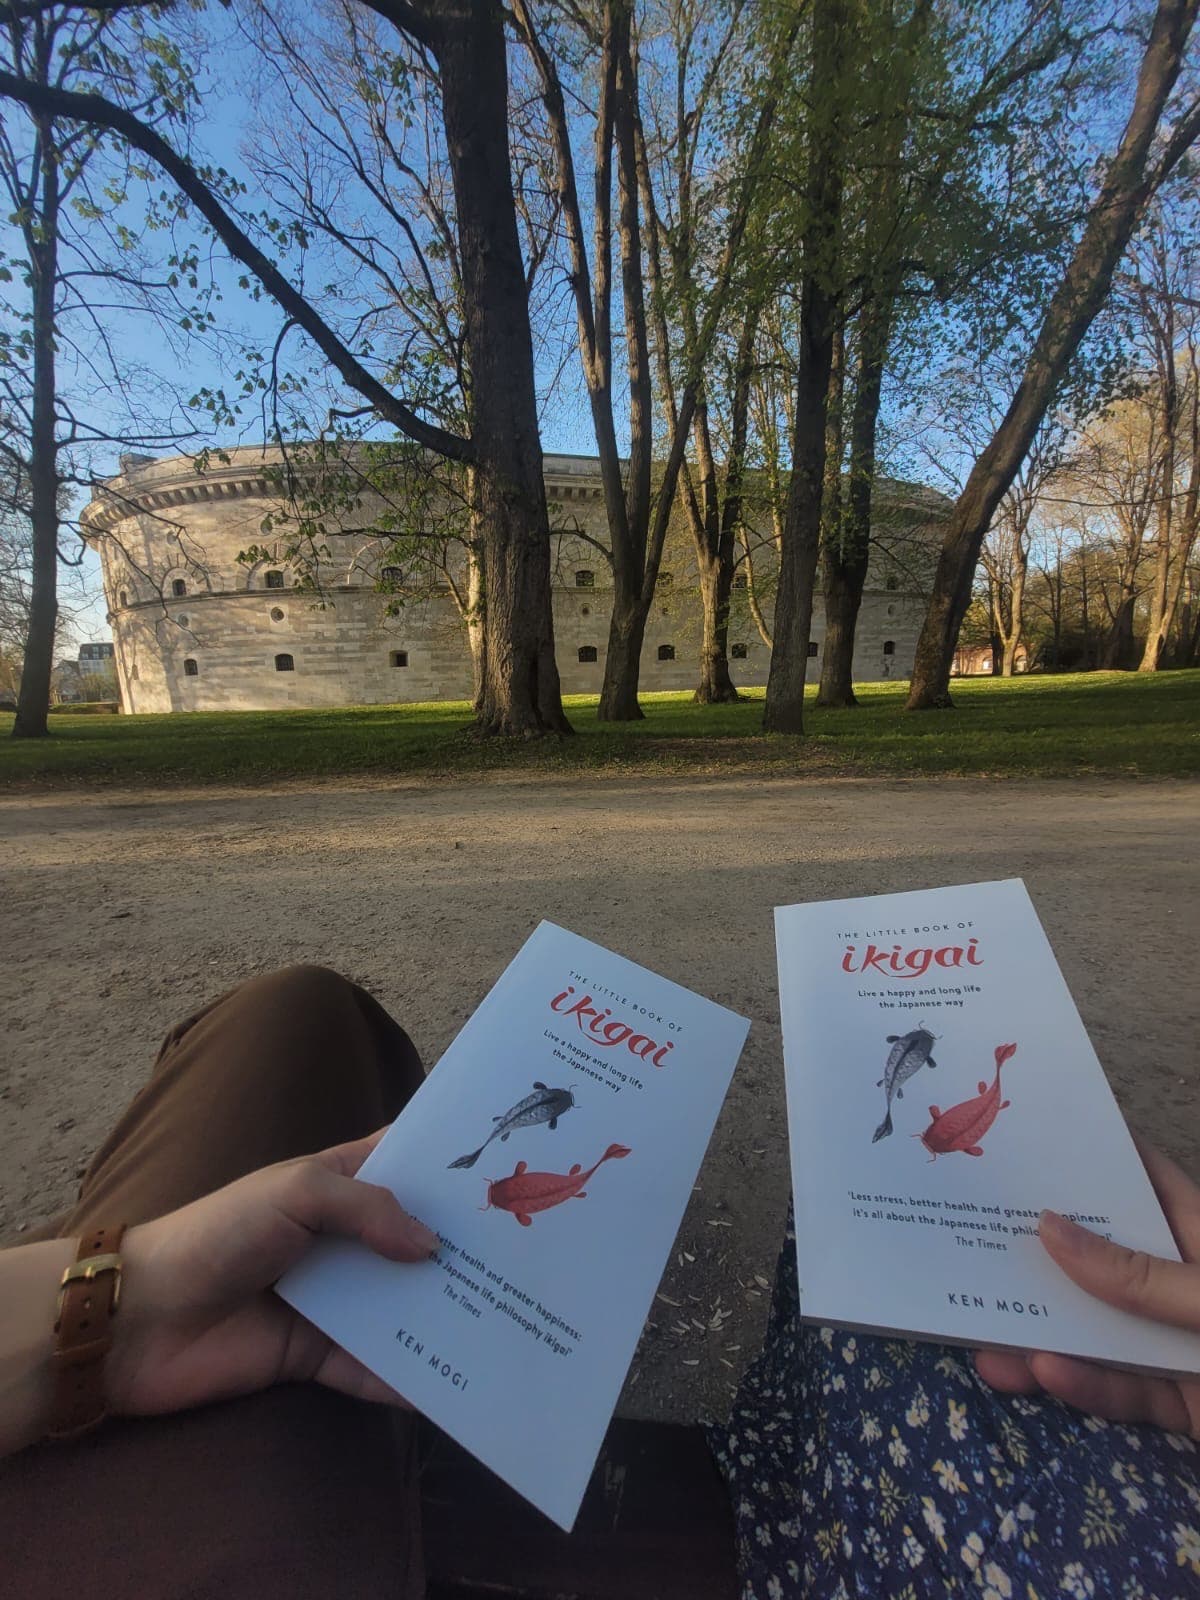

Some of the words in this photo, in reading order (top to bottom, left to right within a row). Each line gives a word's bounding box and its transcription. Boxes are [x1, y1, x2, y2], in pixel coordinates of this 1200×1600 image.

[837, 931, 860, 940] THE
[866, 928, 908, 938] LITTLE
[914, 924, 950, 934] BOOK
[957, 920, 975, 930] OF
[842, 938, 985, 978] ikigai
[569, 970, 589, 984] THE
[592, 983, 628, 1005] LITTLE
[632, 1004, 663, 1023] BOOK
[668, 1022, 683, 1033] OF
[879, 1001, 895, 1009] the
[897, 1000, 942, 1011] Japanese
[945, 999, 965, 1009] way
[887, 988, 916, 999] happy
[918, 987, 937, 997] and
[939, 986, 962, 997] long
[964, 984, 982, 993] life
[550, 986, 674, 1067] ikigai
[543, 1029, 560, 1042] Live
[567, 1042, 592, 1061] happy
[592, 1057, 608, 1070] and
[609, 1065, 628, 1083] long
[628, 1076, 644, 1091] life
[552, 1048, 567, 1061] the
[567, 1057, 604, 1082] Japanese
[605, 1079, 622, 1094] way
[848, 1190, 872, 1202] 'Less
[874, 1194, 908, 1207] stress,
[909, 1196, 942, 1209] better
[944, 1200, 978, 1213] health
[981, 1205, 1001, 1216] and
[1003, 1208, 1041, 1219] greate
[1059, 1213, 1112, 1225] ppiness:
[871, 1209, 883, 1219] all
[886, 1211, 916, 1223] about
[918, 1214, 937, 1225] the
[939, 1216, 988, 1231] Japanese
[989, 1221, 1009, 1234] life
[955, 1235, 975, 1248] The
[977, 1238, 1008, 1251] Times
[443, 1260, 480, 1292] Japanese
[480, 1287, 496, 1304] life
[495, 1301, 543, 1340] philosophy
[443, 1284, 458, 1301] The
[458, 1295, 483, 1319] Times
[460, 1249, 486, 1273] health
[486, 1269, 504, 1285] and
[502, 1282, 535, 1309] greater
[536, 1302, 582, 1342] happiness:
[948, 1293, 985, 1309] KEN
[996, 1299, 1049, 1318] MOGI
[396, 1328, 424, 1356] KEN
[428, 1354, 469, 1391] MOGI
